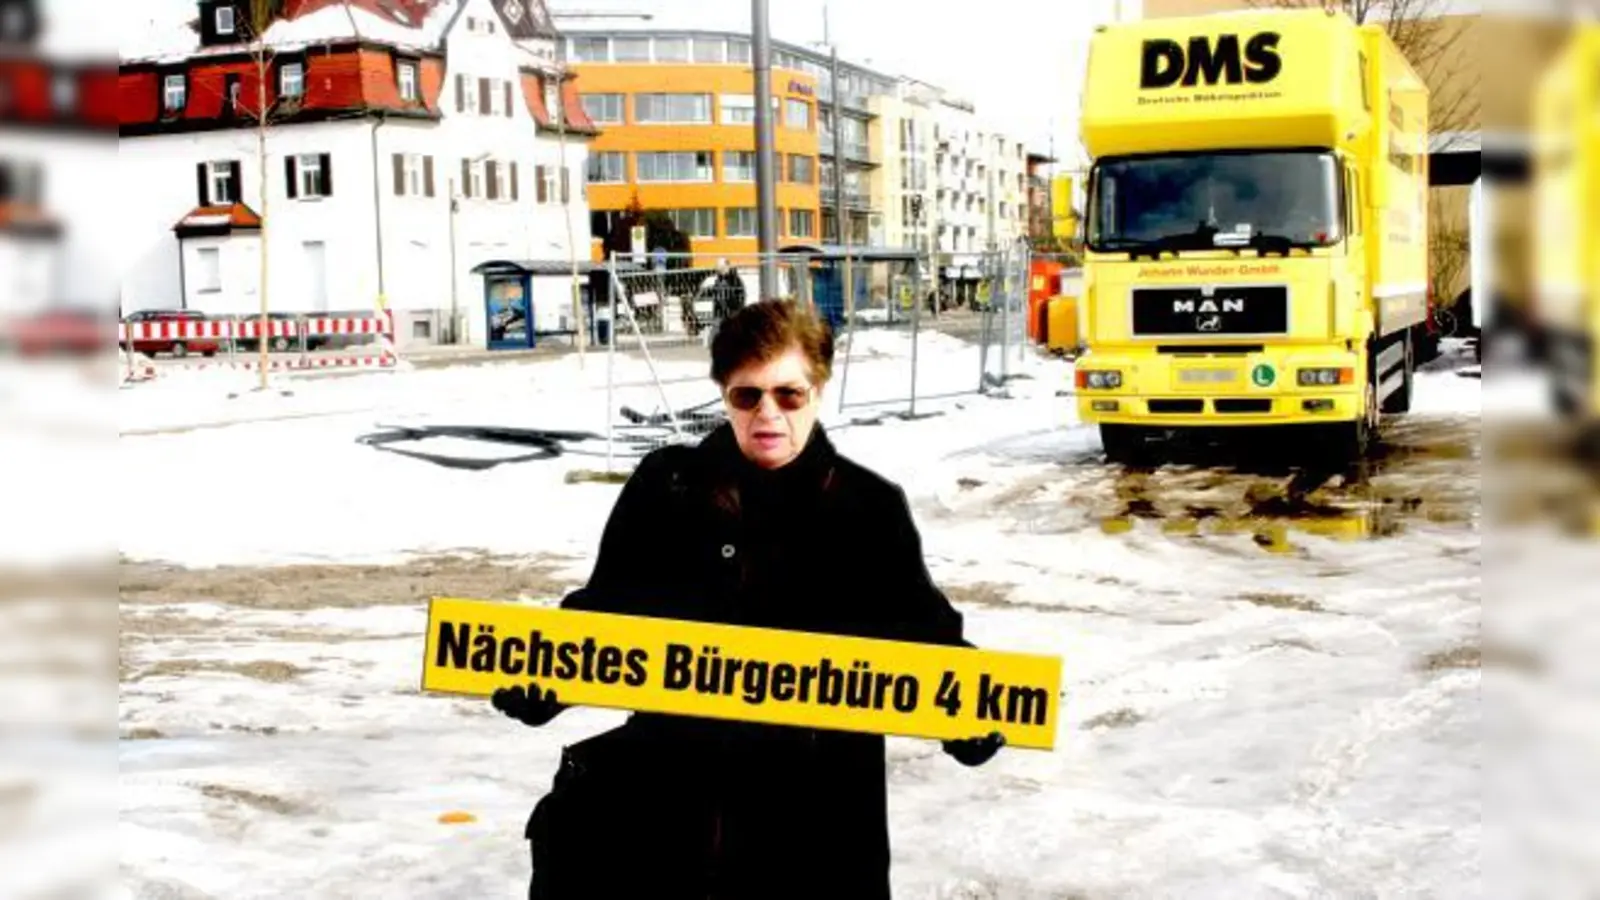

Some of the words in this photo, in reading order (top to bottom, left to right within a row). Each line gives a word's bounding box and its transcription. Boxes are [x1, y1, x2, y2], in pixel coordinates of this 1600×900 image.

[1140, 32, 1282, 88] DMS
[1186, 264, 1235, 276] Wunder
[1238, 264, 1279, 275] GmbH
[1173, 299, 1244, 313] MAN
[1256, 366, 1270, 384] L
[436, 621, 648, 687] Nächstes
[663, 643, 919, 717] Bürgerbüro
[934, 671, 962, 717] 4
[976, 673, 1048, 726] km
